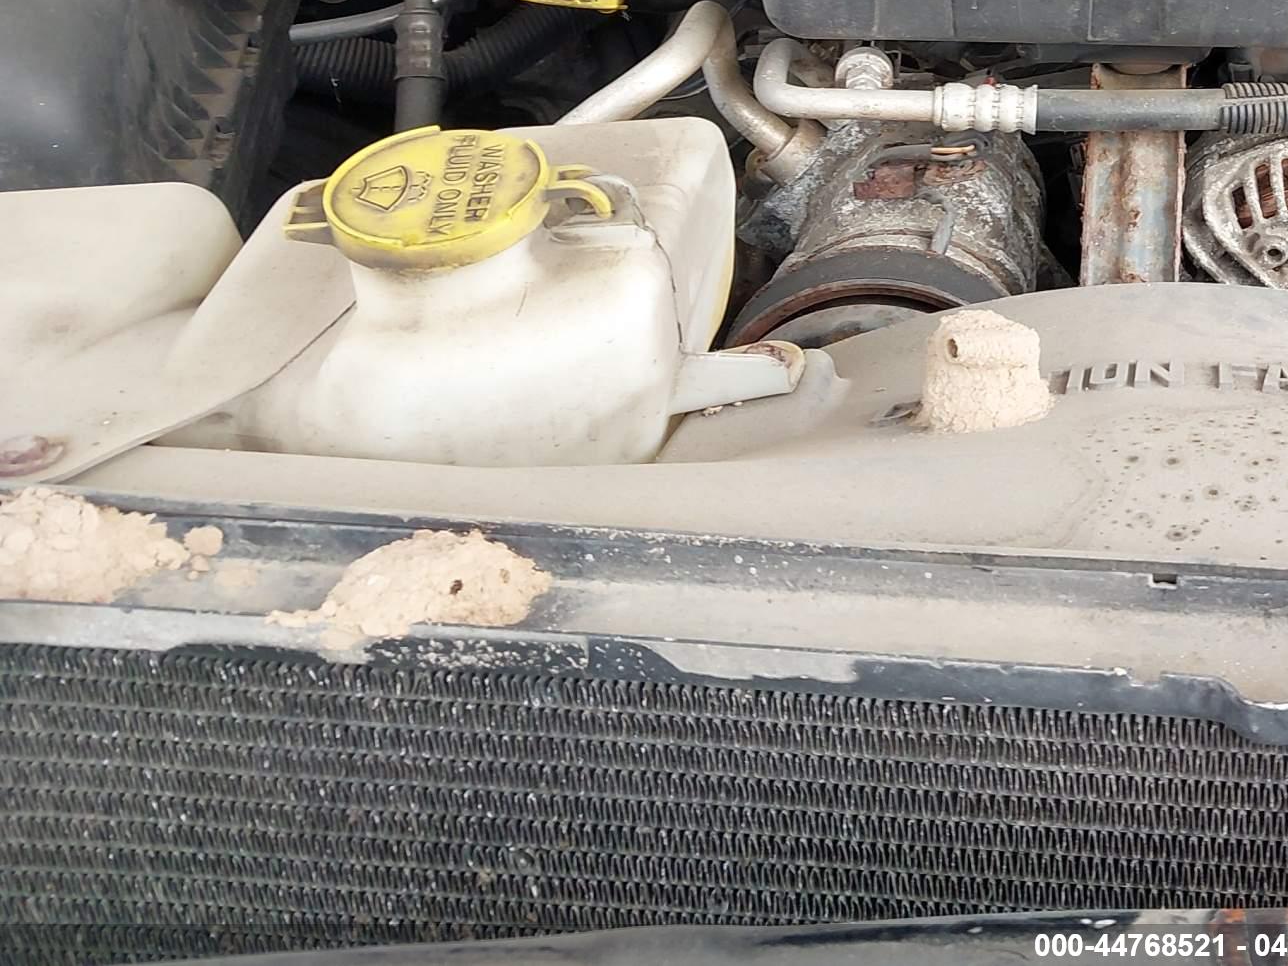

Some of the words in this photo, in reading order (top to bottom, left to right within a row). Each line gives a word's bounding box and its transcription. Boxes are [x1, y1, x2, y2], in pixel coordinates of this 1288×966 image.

[442, 134, 477, 183] FLUID
[463, 142, 505, 223] WASHER
[425, 187, 463, 235] ONLY
